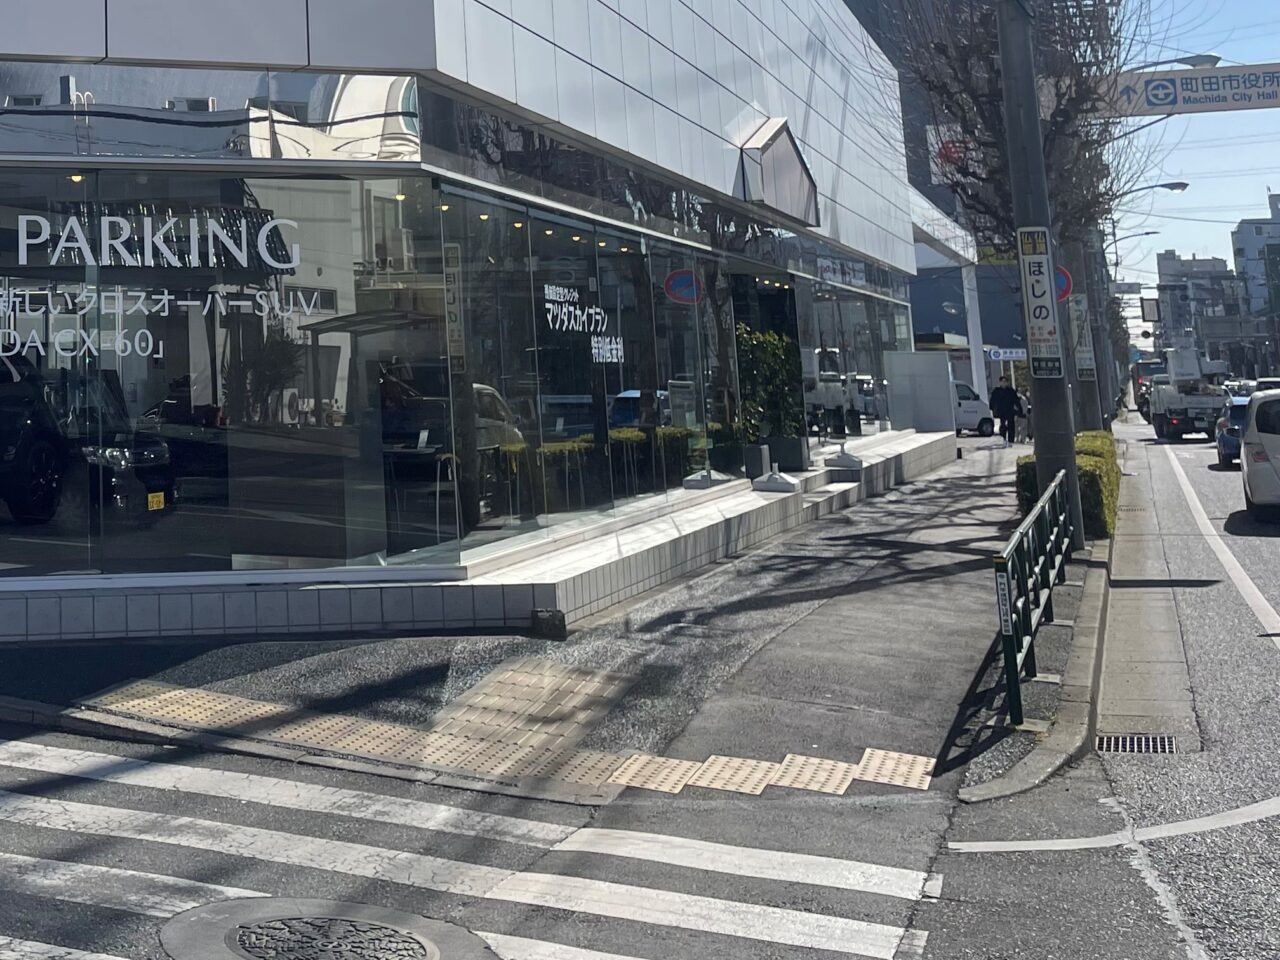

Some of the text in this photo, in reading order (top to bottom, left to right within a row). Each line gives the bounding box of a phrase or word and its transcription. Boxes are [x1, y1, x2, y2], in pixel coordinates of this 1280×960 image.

[1180, 71, 1280, 93] 町田市役所
[1182, 90, 1279, 105] Machida City Hall
[17, 214, 301, 270] PARKING
[1027, 261, 1050, 320] ほしの
